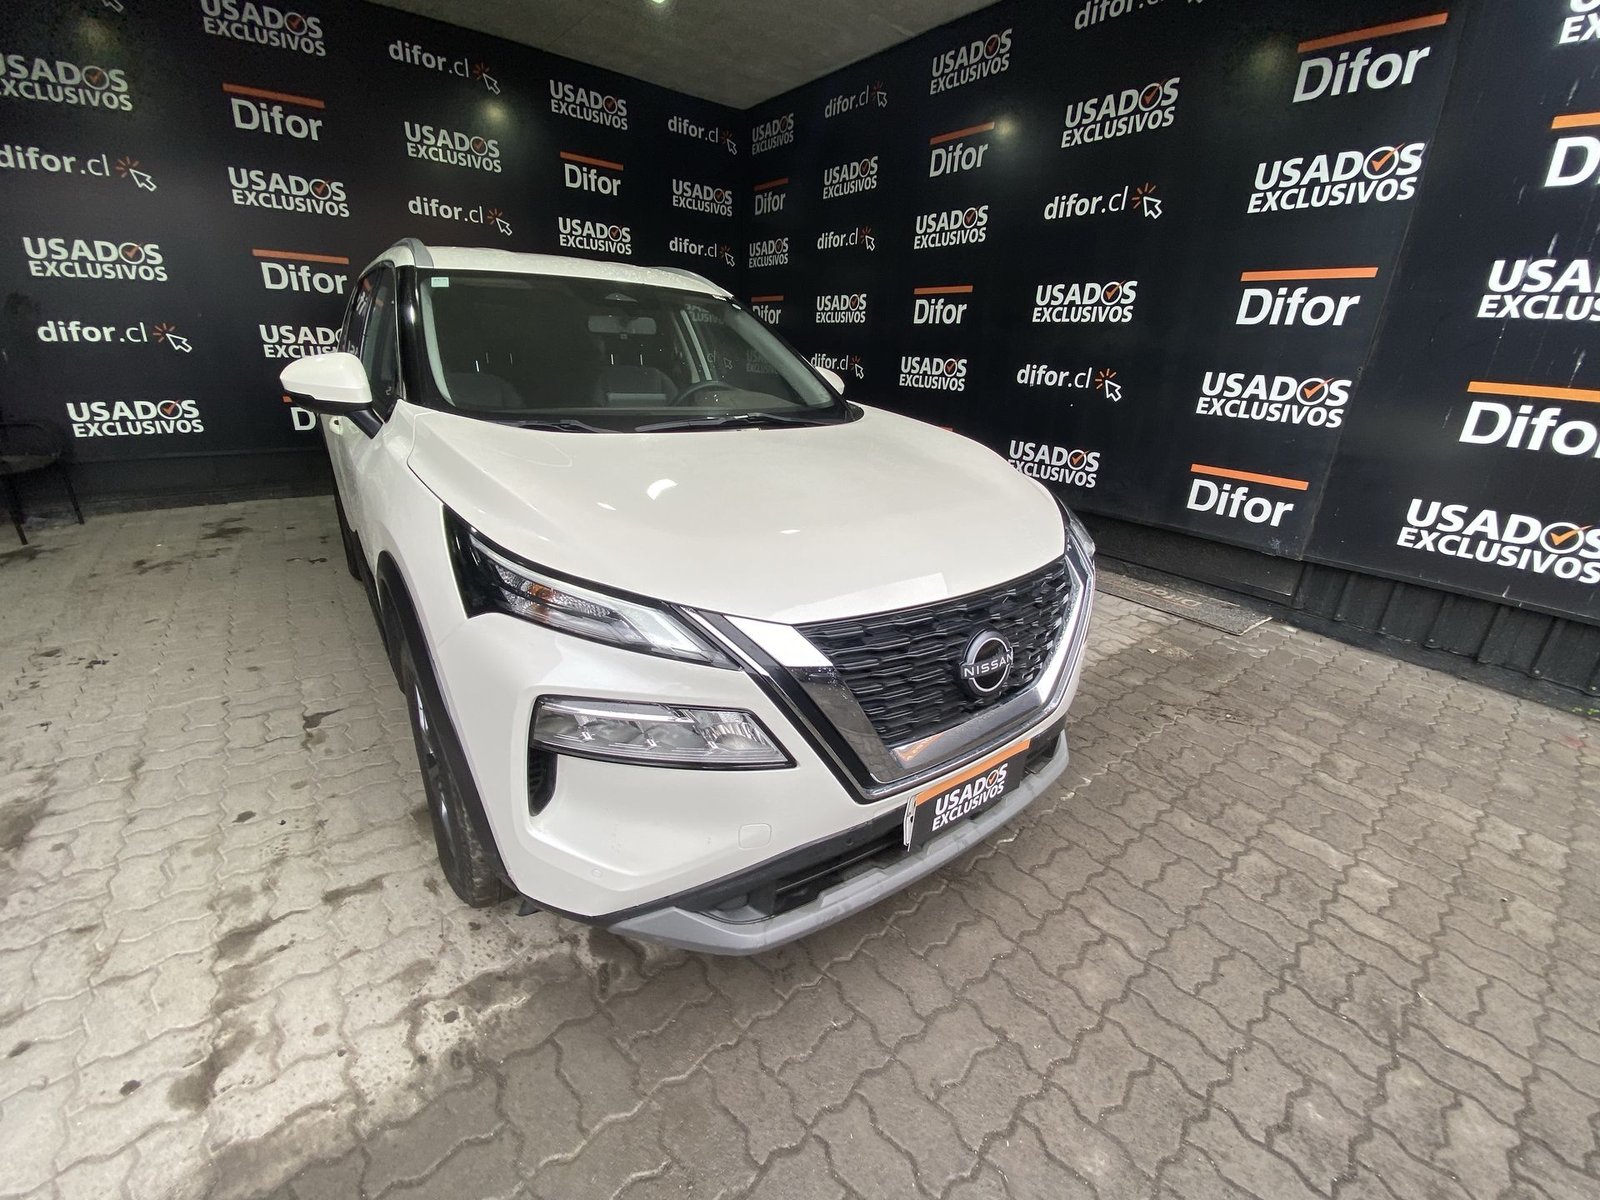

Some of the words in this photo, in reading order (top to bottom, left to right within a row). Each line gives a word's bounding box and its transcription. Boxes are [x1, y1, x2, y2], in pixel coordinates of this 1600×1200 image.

[201, 0, 323, 39] USADOS
[1074, 0, 1164, 30] difor.
[203, 16, 326, 57] EXCLUSIVOS
[389, 40, 469, 78] difor.cl
[932, 28, 1012, 77] USADOS
[929, 53, 1010, 95] EXCLUSIVOS
[1292, 46, 1431, 103] Difor
[0, 78, 133, 112] XCLUSIVOS
[550, 79, 627, 116] USADOS
[825, 85, 869, 119] difor.cl
[1064, 77, 1180, 128] USADOS
[230, 98, 323, 141] Difor
[551, 99, 628, 131] EXCLUSIVOS
[668, 116, 719, 144] difor.cl
[752, 113, 794, 142] USADOS
[1061, 106, 1176, 148] EXCLUSIVOS
[404, 121, 500, 157] USADOS
[752, 132, 794, 155] EXCLUSIVOS
[0, 144, 110, 177] difor.cl
[407, 142, 502, 173] EXCLUSIVOS
[823, 156, 878, 186] USADOS
[929, 143, 988, 178] Difor
[1254, 142, 1426, 191] USADOS
[227, 166, 347, 202] USADOS
[564, 163, 621, 196] Difor
[672, 179, 732, 205] USADOS
[823, 175, 877, 200] EXCLUSIVOS
[231, 190, 350, 218] EXCLUSIVOS
[408, 196, 484, 224] difor.cl
[672, 195, 733, 217] EXCLUSIVOS
[755, 191, 786, 216] Difor
[1044, 186, 1129, 220] difor.cl
[1247, 177, 1418, 214] EXCLUSIVOS
[558, 217, 631, 243] USADOS
[915, 205, 988, 234] USADOS
[23, 237, 164, 265] USADOS
[560, 233, 632, 255] EXCLUSIVOS
[669, 237, 717, 258] difor.cl
[749, 237, 789, 257] USADOS
[817, 228, 858, 250] difor.cl
[914, 227, 986, 250] EXCLUSIVOS
[28, 260, 168, 282] EXCLUSIVOS
[749, 253, 788, 269] EXCLUSIVOS
[1488, 259, 1600, 293] USA
[260, 262, 348, 295] Difor
[1035, 280, 1138, 306] USADOS
[816, 294, 867, 311] USADOS
[816, 311, 866, 323] EXCLUSIVOS
[914, 299, 967, 324] Difor
[1032, 305, 1134, 323] EXCLUSIVOS
[1235, 286, 1361, 326] Difor
[37, 320, 148, 343] difor.cl
[810, 353, 849, 371] difor.cl
[901, 356, 967, 377] USADOS
[1016, 364, 1092, 389] difor.cl
[899, 374, 965, 391] EXCLUSIVOS
[1202, 371, 1352, 406] USADOS
[66, 399, 200, 423] USADOS
[1196, 397, 1345, 428] EXCLUSIVOS
[72, 419, 204, 437] EXCLUSIVOS
[1459, 401, 1600, 459] Difo
[1009, 440, 1100, 472] USADOS
[1186, 478, 1294, 527] Difor
[1406, 498, 1600, 560] USADOS
[1397, 526, 1600, 584] EXCLUSIVOS
[963, 651, 1014, 678] NISSAN
[935, 763, 1008, 815] USADOS
[932, 780, 1005, 832] EXCLUSIVOS
